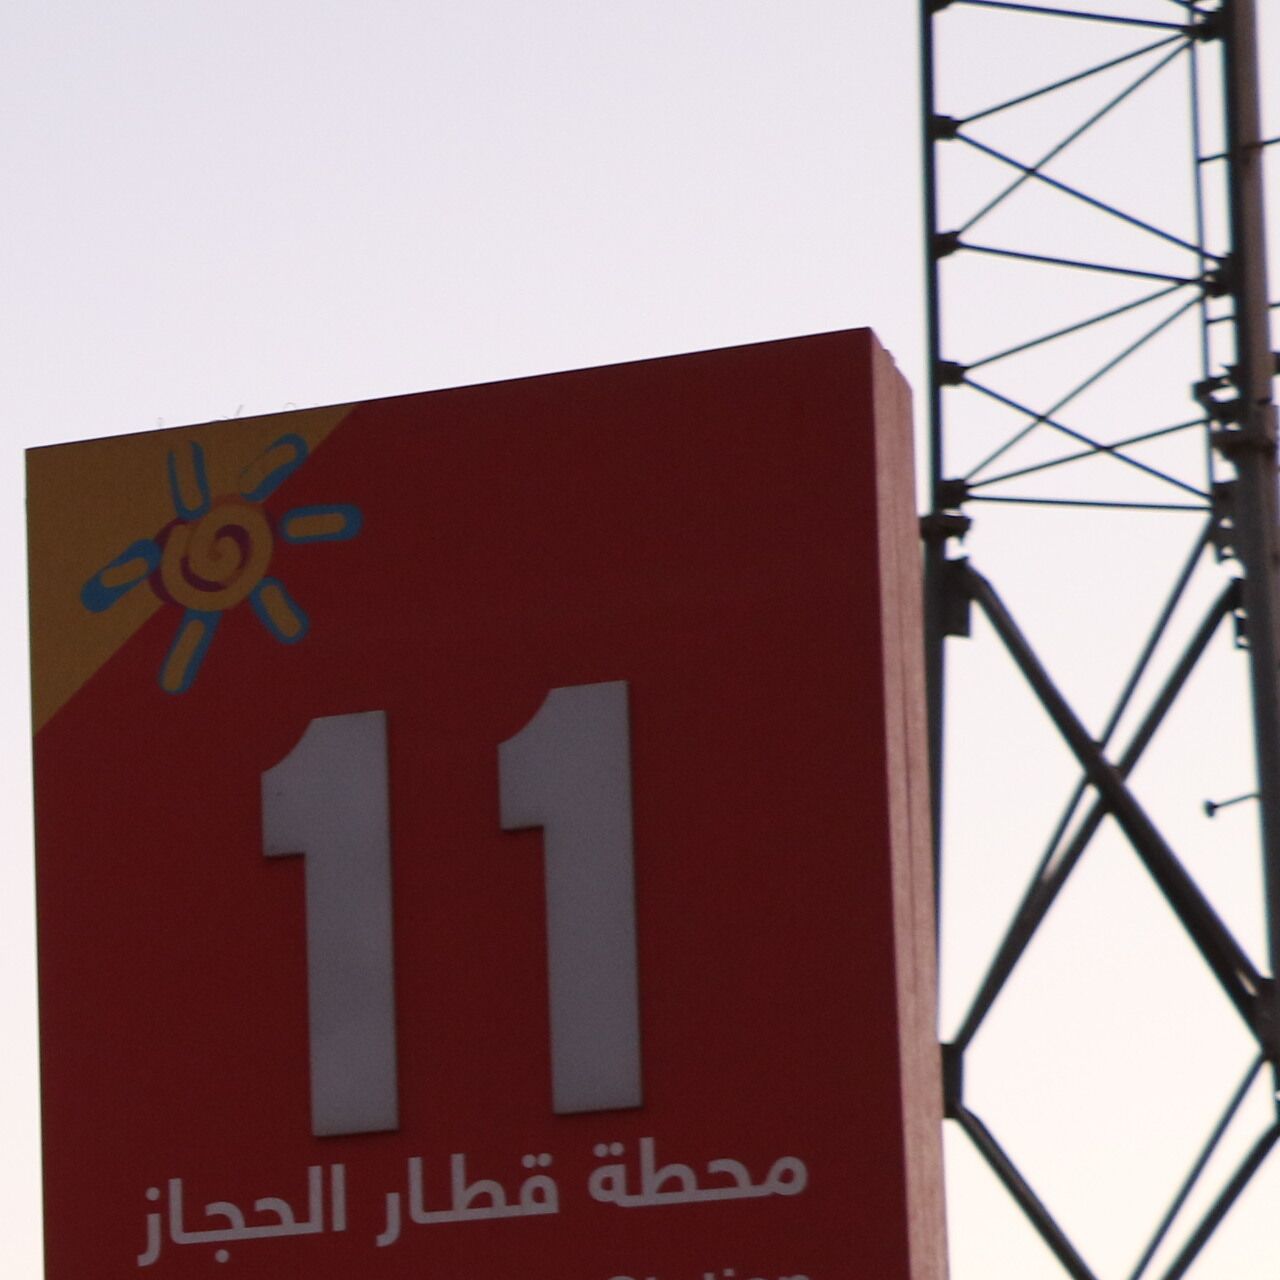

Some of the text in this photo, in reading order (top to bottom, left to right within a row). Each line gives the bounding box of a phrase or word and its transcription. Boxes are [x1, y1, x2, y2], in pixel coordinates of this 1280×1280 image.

[261, 680, 643, 1138] 11
[137, 1136, 808, 1267] محطة قطار الحجاز
